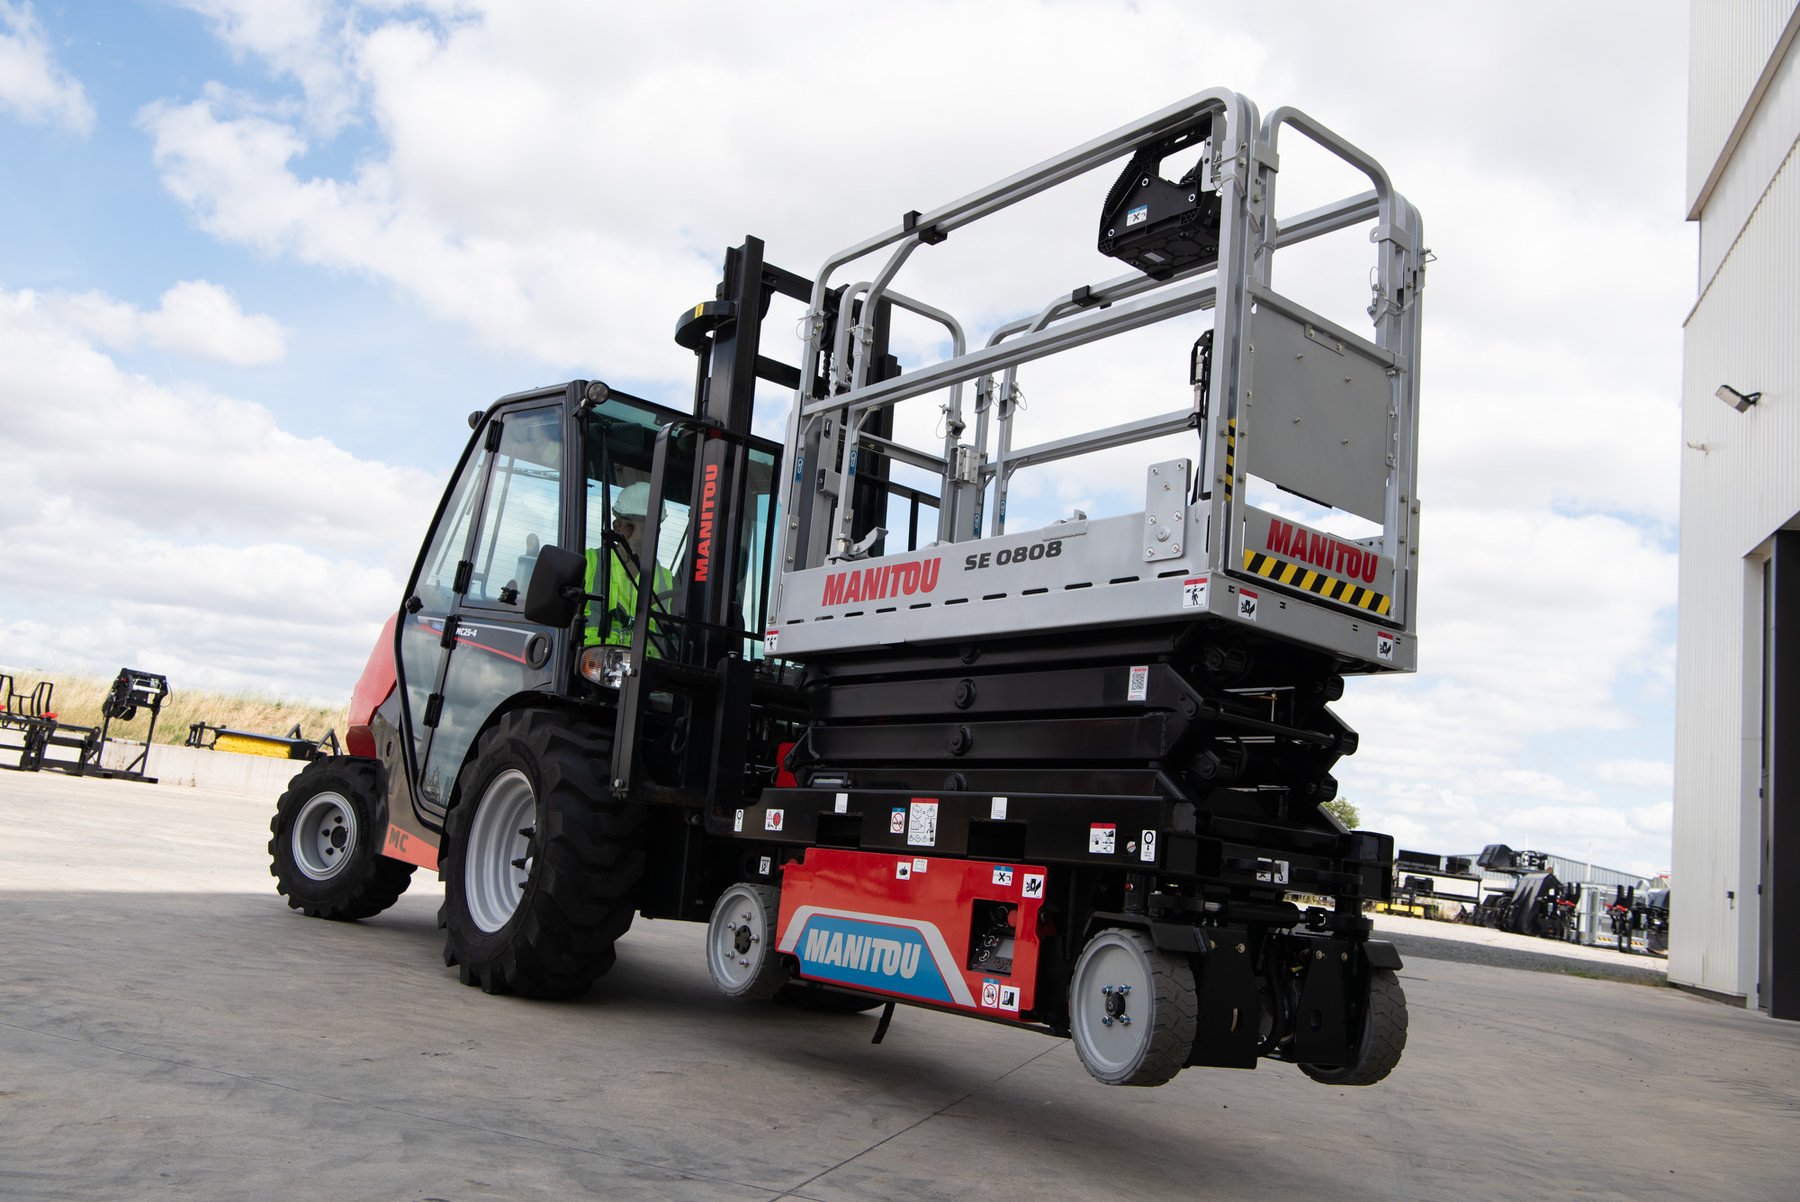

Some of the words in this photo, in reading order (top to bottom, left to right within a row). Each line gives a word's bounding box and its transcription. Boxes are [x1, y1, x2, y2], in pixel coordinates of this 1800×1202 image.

[694, 464, 718, 582] MANITOU
[964, 553, 992, 571] SE
[996, 541, 1062, 566] 0808
[1266, 518, 1379, 584] MANITOU
[821, 558, 940, 606] MANITOU
[456, 627, 477, 637] MC25-4
[389, 827, 408, 854] MC
[804, 929, 921, 979] MANITOU
